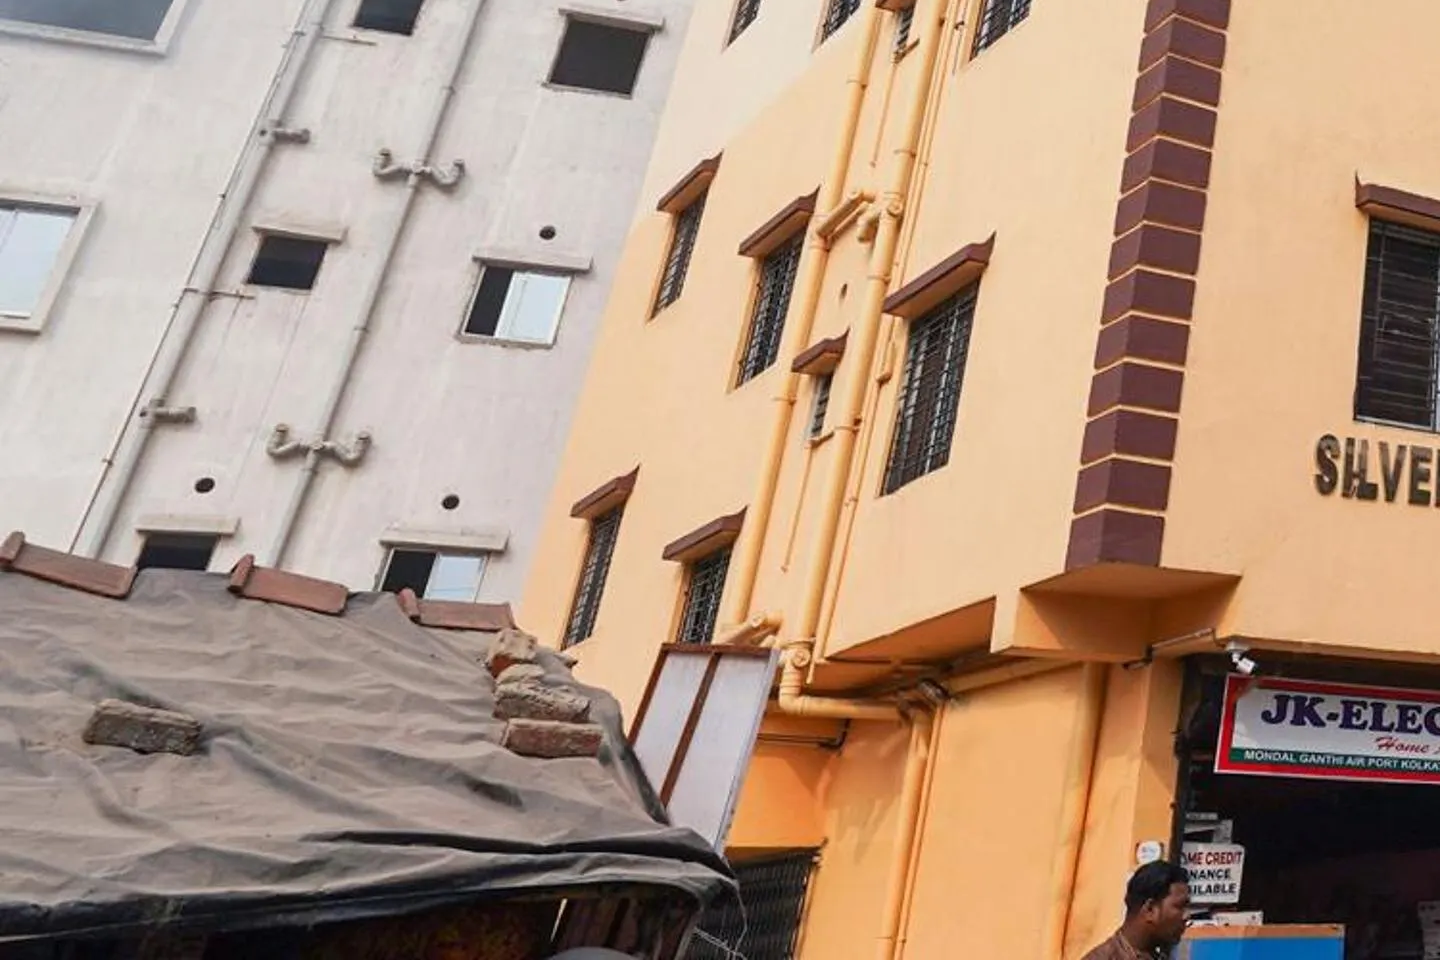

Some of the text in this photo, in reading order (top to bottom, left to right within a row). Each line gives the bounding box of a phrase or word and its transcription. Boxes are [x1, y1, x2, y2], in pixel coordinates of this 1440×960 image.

[1375, 736, 1429, 754] Home
[1244, 749, 1297, 763] MONDAL
[1299, 752, 1344, 765] GANTHI
[1345, 755, 1366, 766] AIR
[1368, 756, 1399, 769] PORT
[1205, 851, 1242, 865] CREDIT
